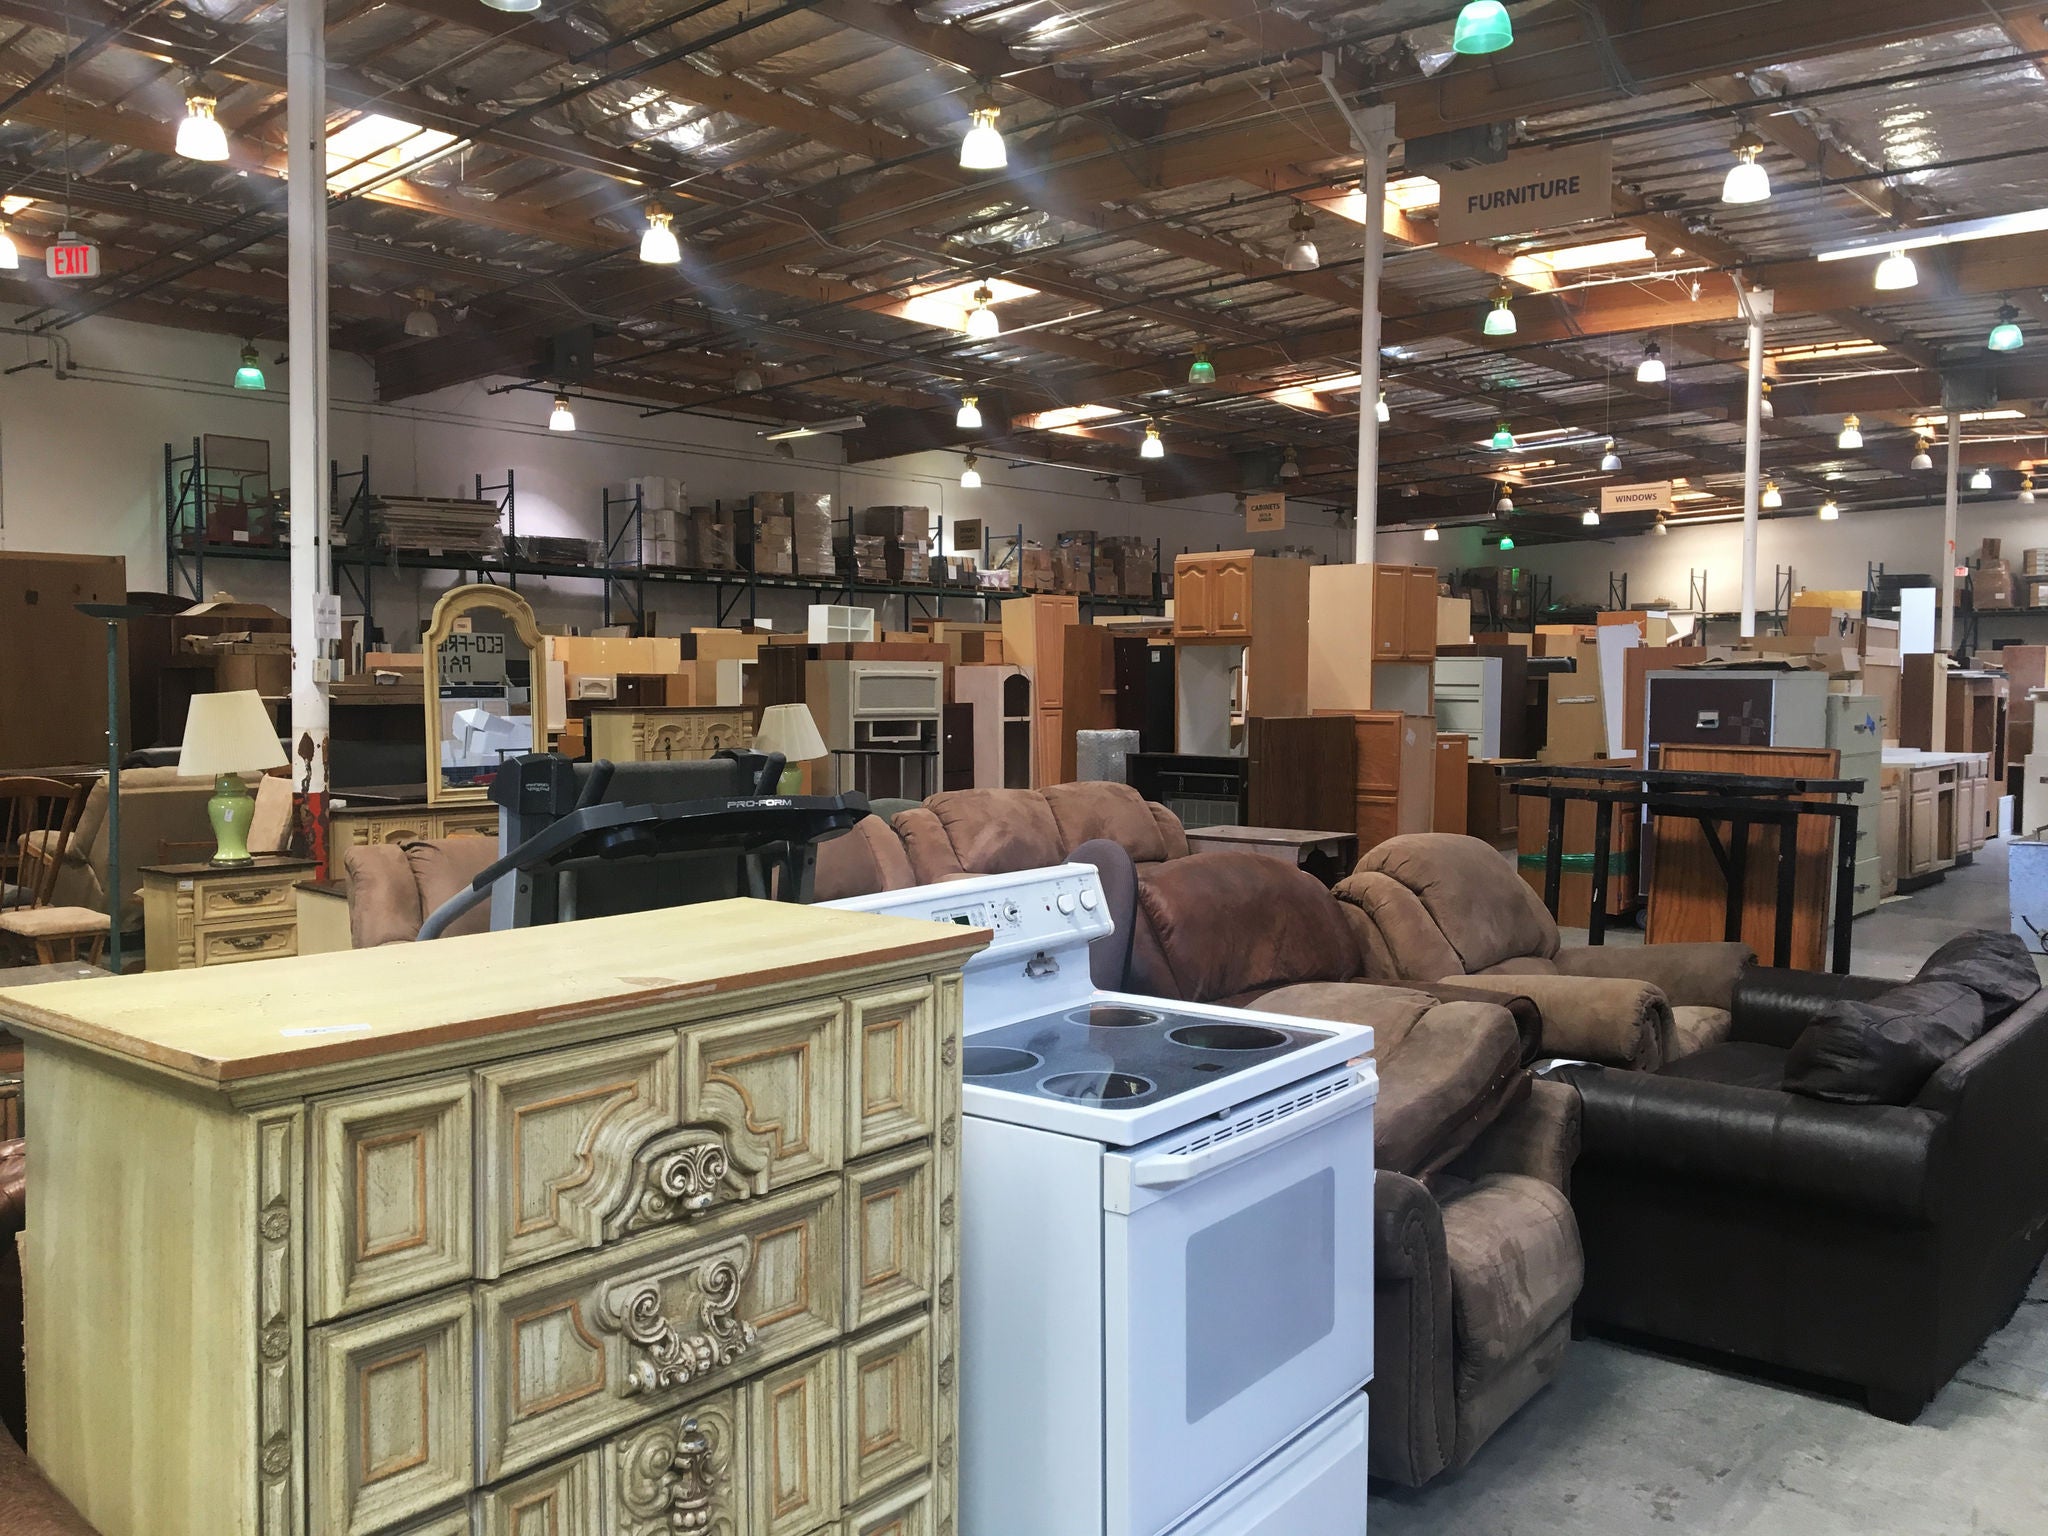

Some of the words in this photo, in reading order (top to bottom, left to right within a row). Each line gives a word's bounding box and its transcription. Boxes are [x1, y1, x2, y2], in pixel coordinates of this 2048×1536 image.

[1467, 175, 1581, 214] FURNITURE
[53, 245, 90, 275] EXIT
[1615, 492, 1657, 503] WINDOWS
[1250, 503, 1281, 512] CABINETS
[726, 798, 793, 809] PRO-FORM
